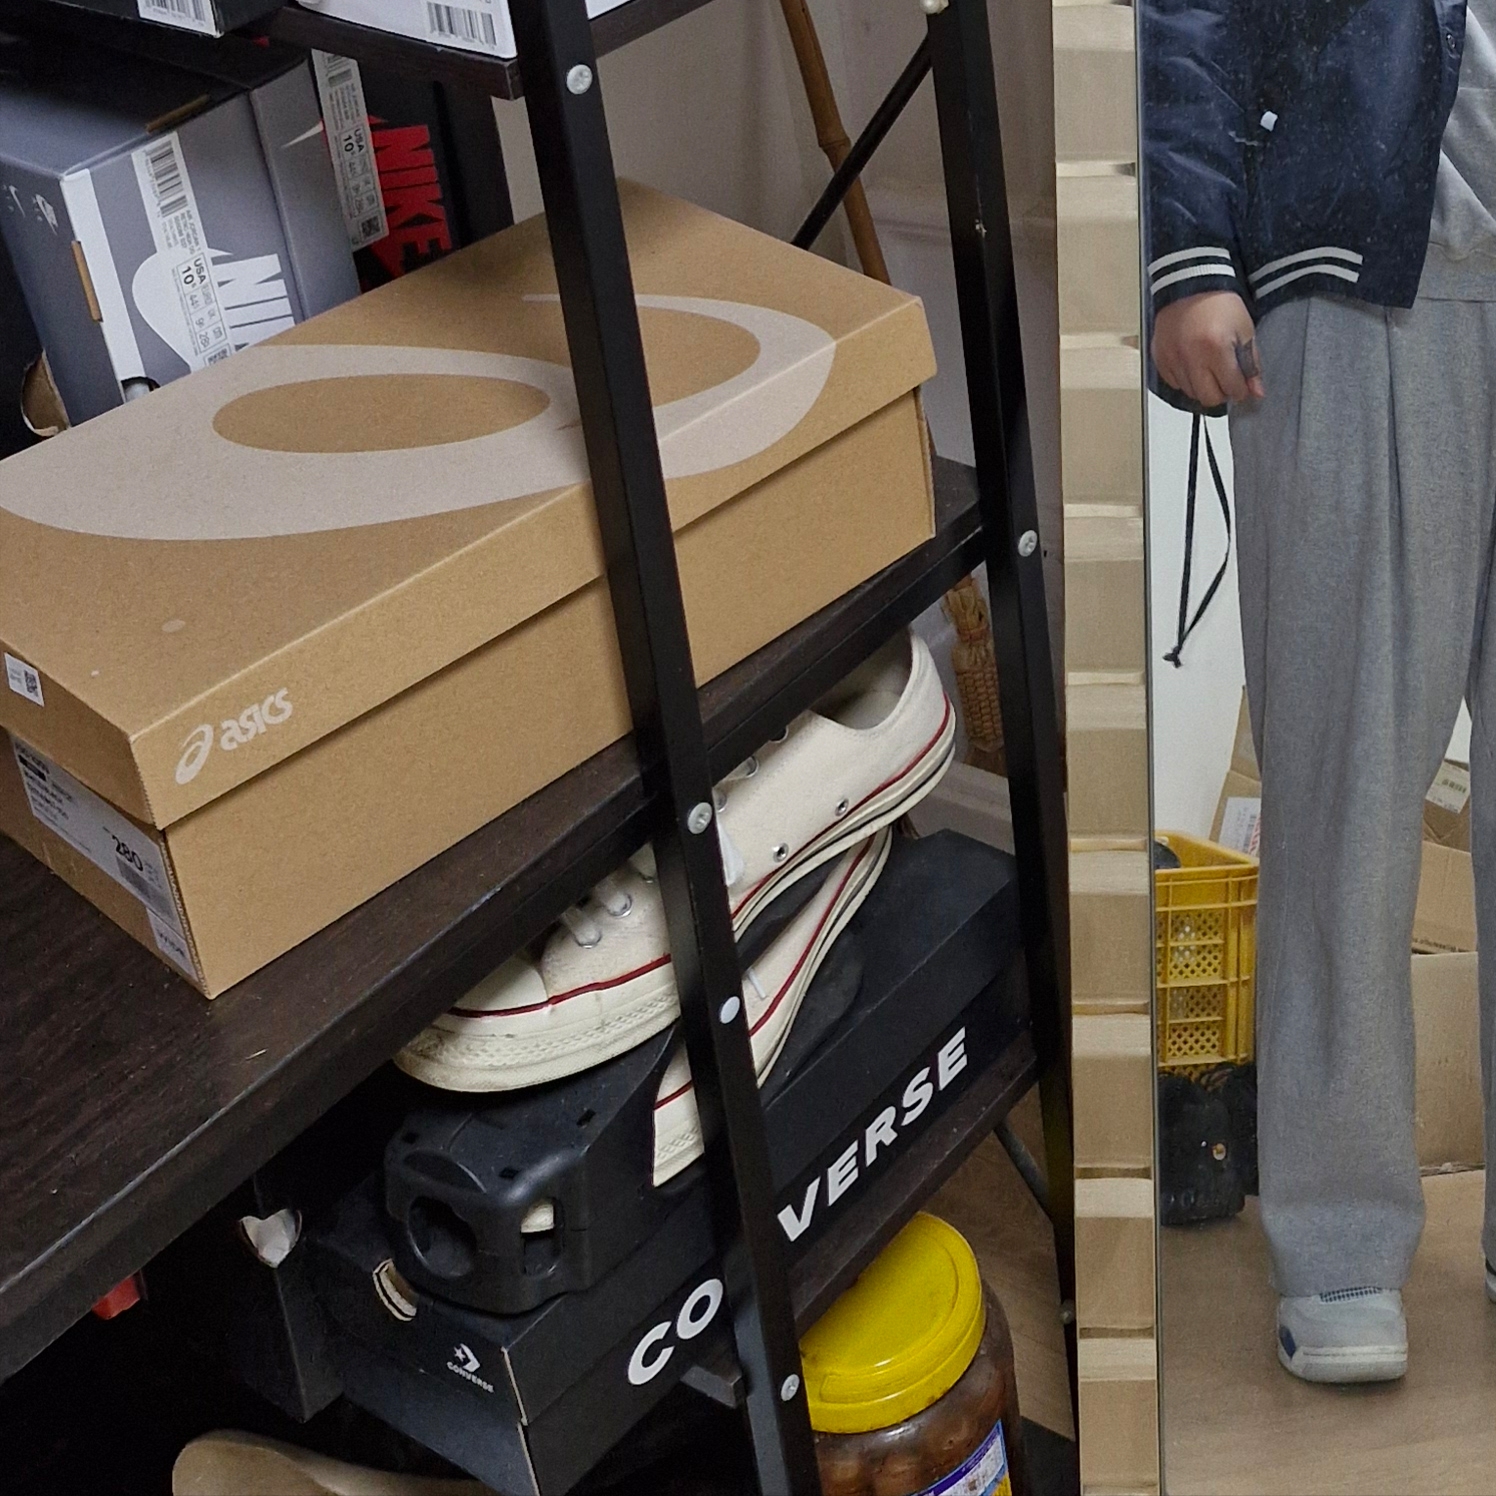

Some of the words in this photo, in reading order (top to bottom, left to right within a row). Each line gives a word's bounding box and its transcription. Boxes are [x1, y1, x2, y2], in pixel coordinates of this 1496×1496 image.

[354, 128, 365, 153] USA
[372, 124, 452, 255] NIKE
[193, 257, 207, 285] USA
[220, 687, 294, 751] asics
[111, 833, 144, 872] 280
[446, 1360, 494, 1393] CONVERSE
